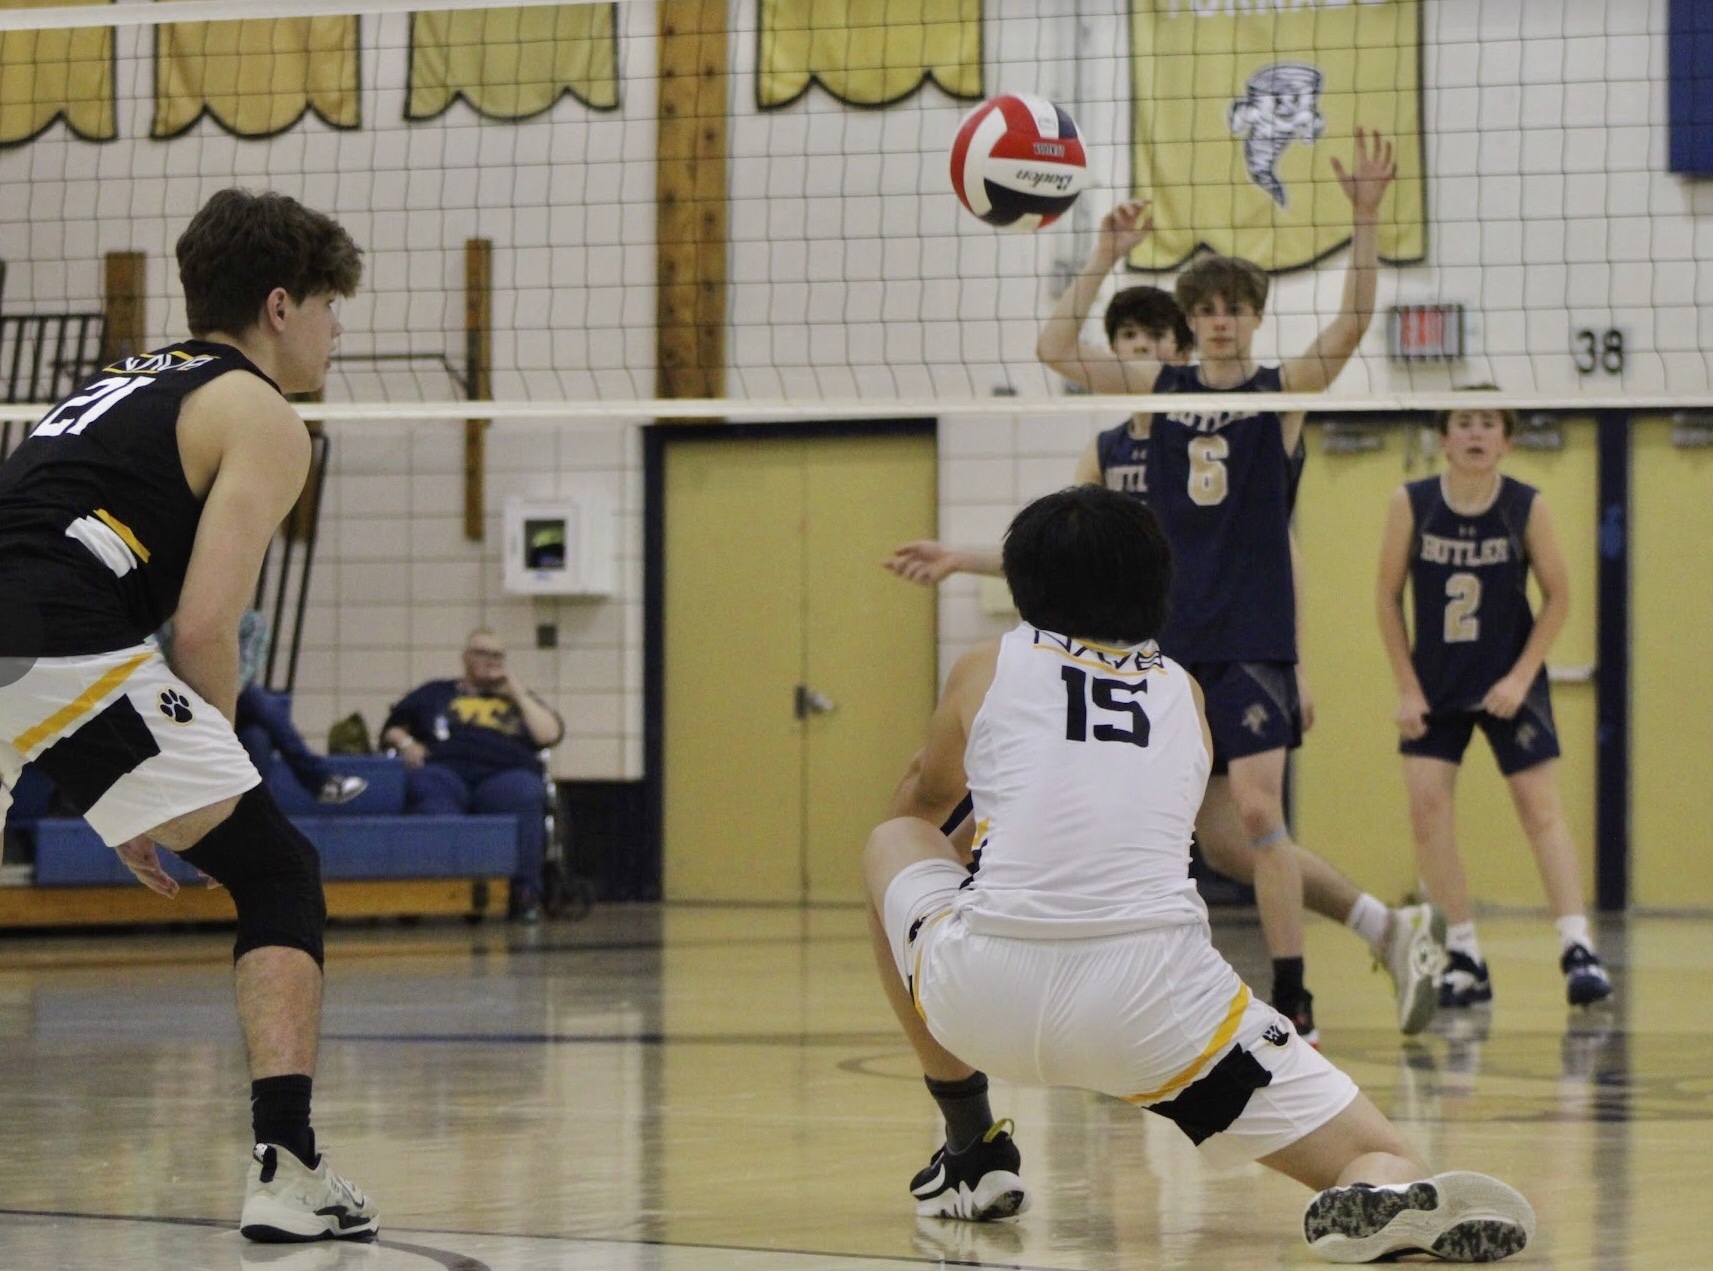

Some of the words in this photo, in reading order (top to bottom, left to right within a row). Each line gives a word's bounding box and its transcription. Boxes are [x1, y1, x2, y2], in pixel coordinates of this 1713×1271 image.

[1576, 329, 1624, 375] 38
[29, 375, 157, 438] 21
[1187, 433, 1229, 506] 6
[1420, 533, 1509, 567] BUTLER
[1443, 572, 1481, 643] 2
[1061, 665, 1150, 748] 15
